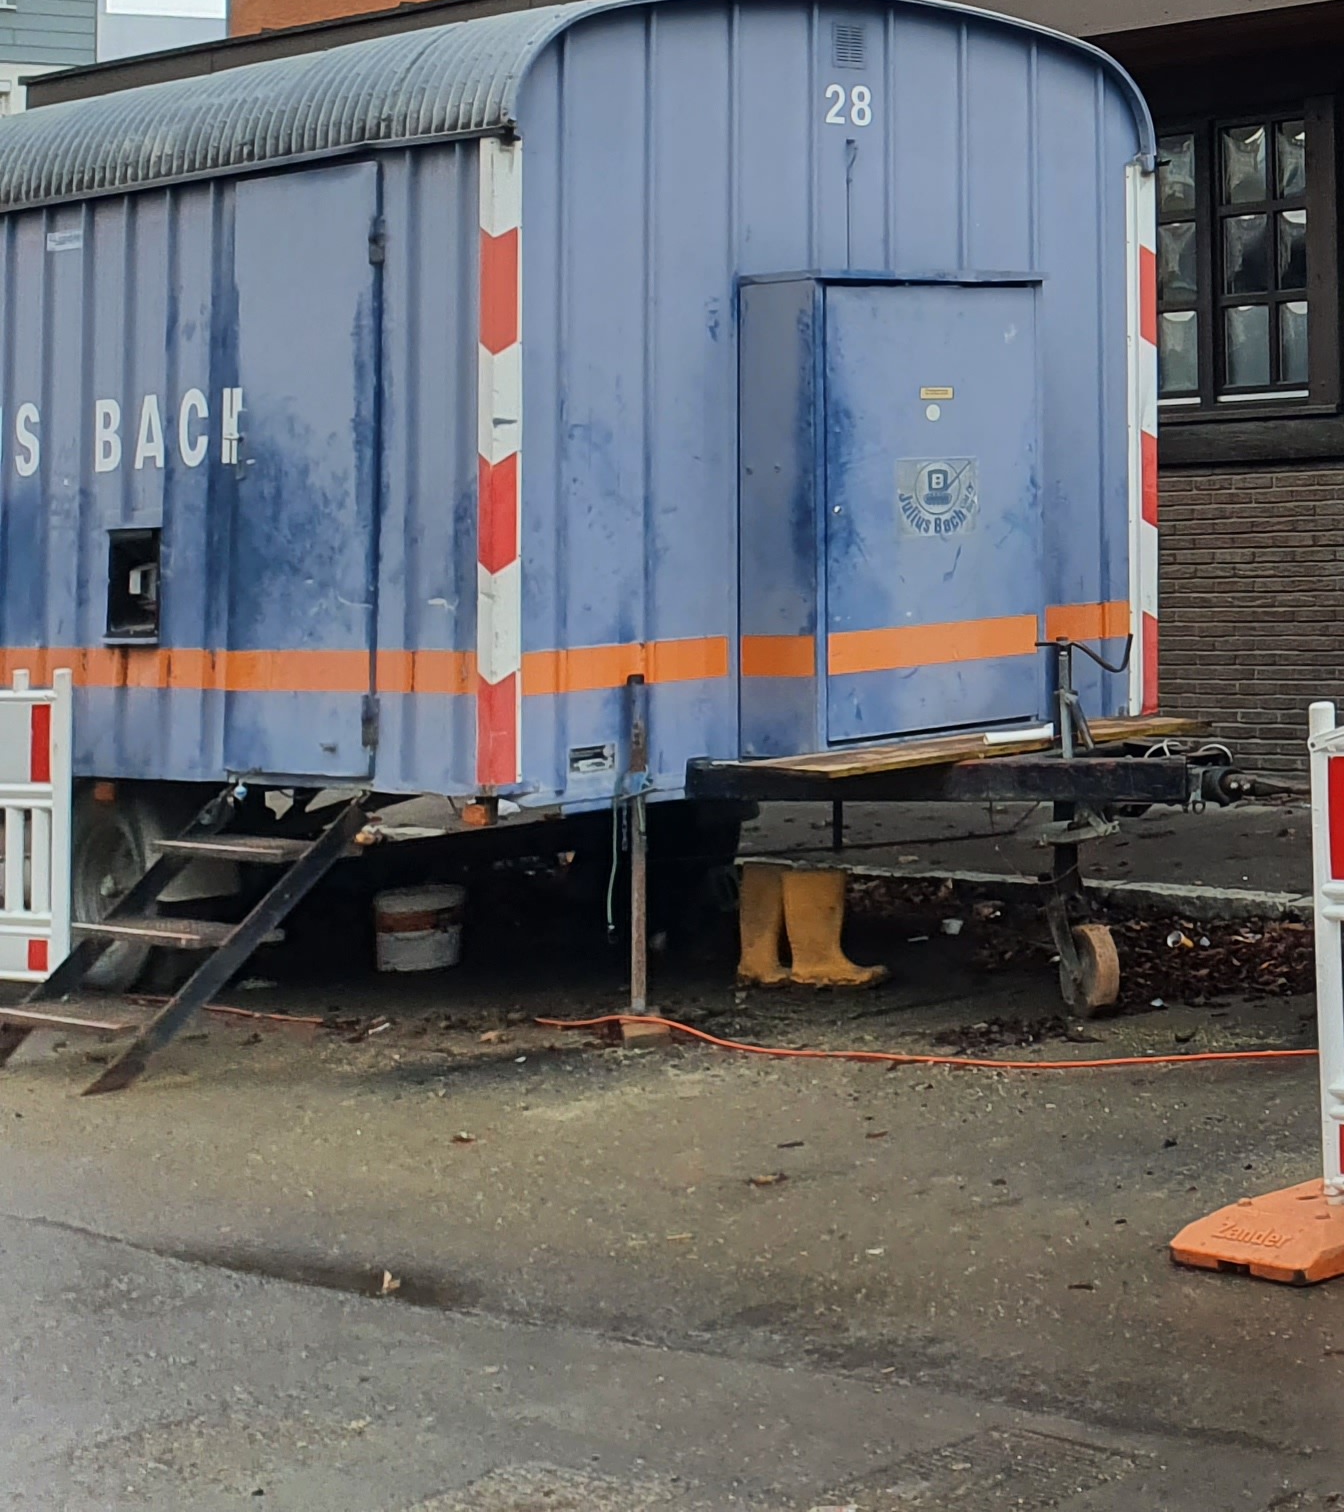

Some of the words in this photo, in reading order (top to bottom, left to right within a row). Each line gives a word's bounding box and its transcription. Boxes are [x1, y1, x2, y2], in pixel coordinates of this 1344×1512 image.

[825, 83, 872, 126] 28
[898, 493, 931, 534] Julius
[1210, 1220, 1294, 1249] Zander
